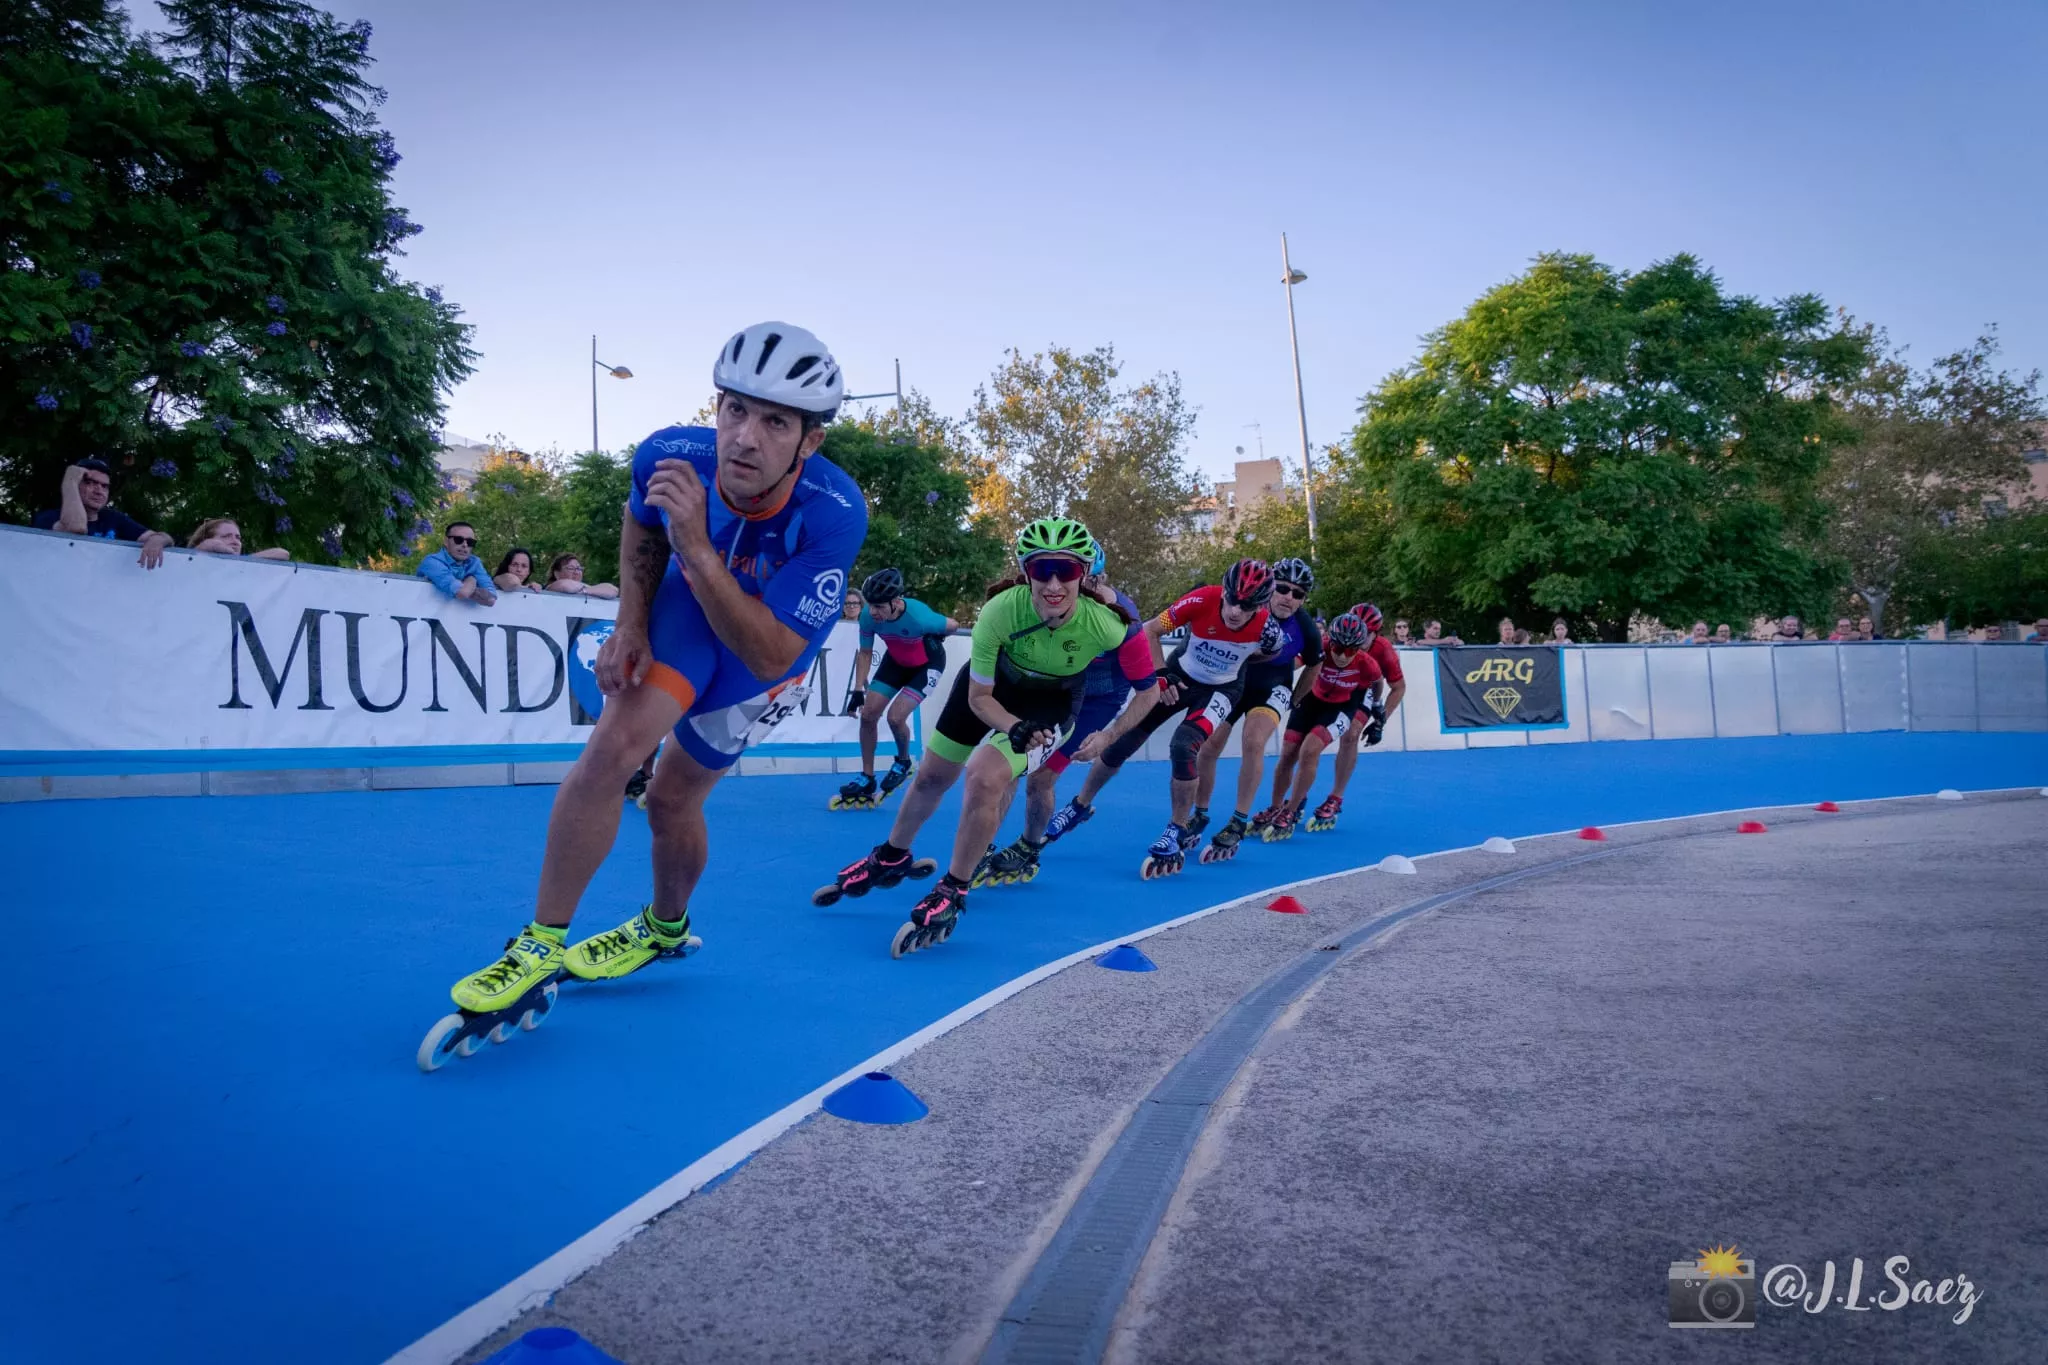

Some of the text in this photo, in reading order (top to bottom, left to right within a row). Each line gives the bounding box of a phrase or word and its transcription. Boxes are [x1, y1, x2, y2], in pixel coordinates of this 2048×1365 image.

[217, 600, 565, 714] MUND
[1198, 640, 1240, 662] Arola
[1465, 658, 1534, 685] ARG
[1210, 699, 1226, 721] 29
[516, 938, 552, 961] SR
